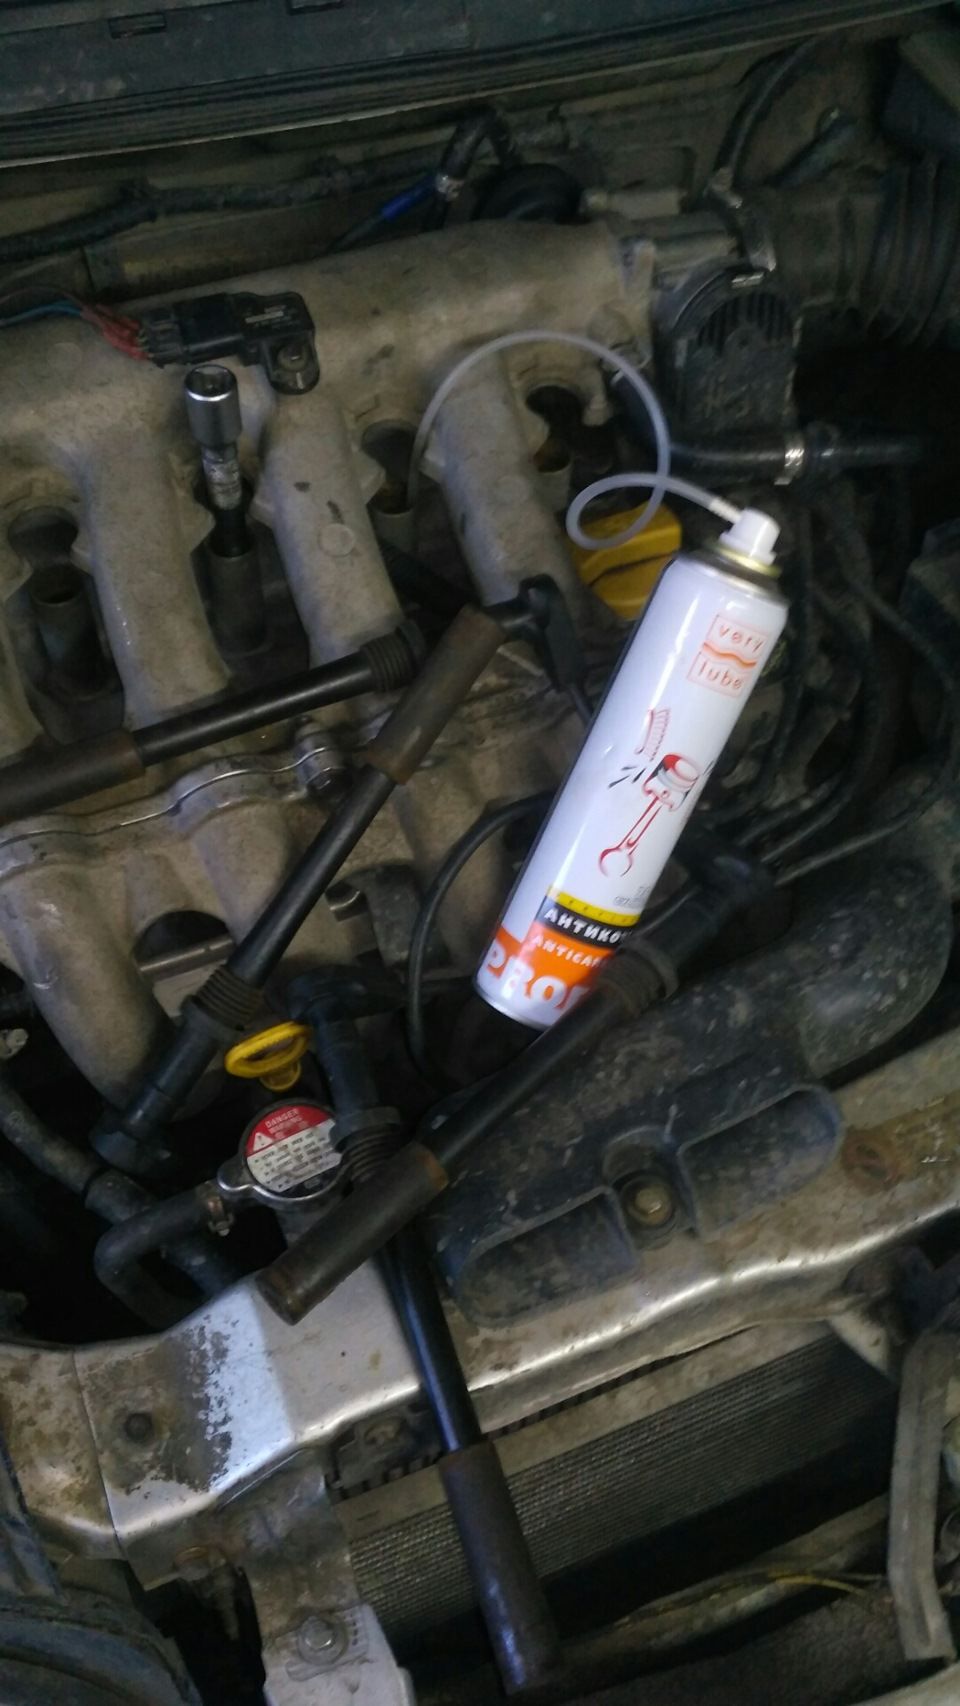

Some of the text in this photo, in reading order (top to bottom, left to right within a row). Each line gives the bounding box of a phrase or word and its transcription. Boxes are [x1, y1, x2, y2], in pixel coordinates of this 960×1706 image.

[719, 626, 763, 653] very
[699, 660, 741, 690] lube
[264, 1107, 300, 1128] DANGER
